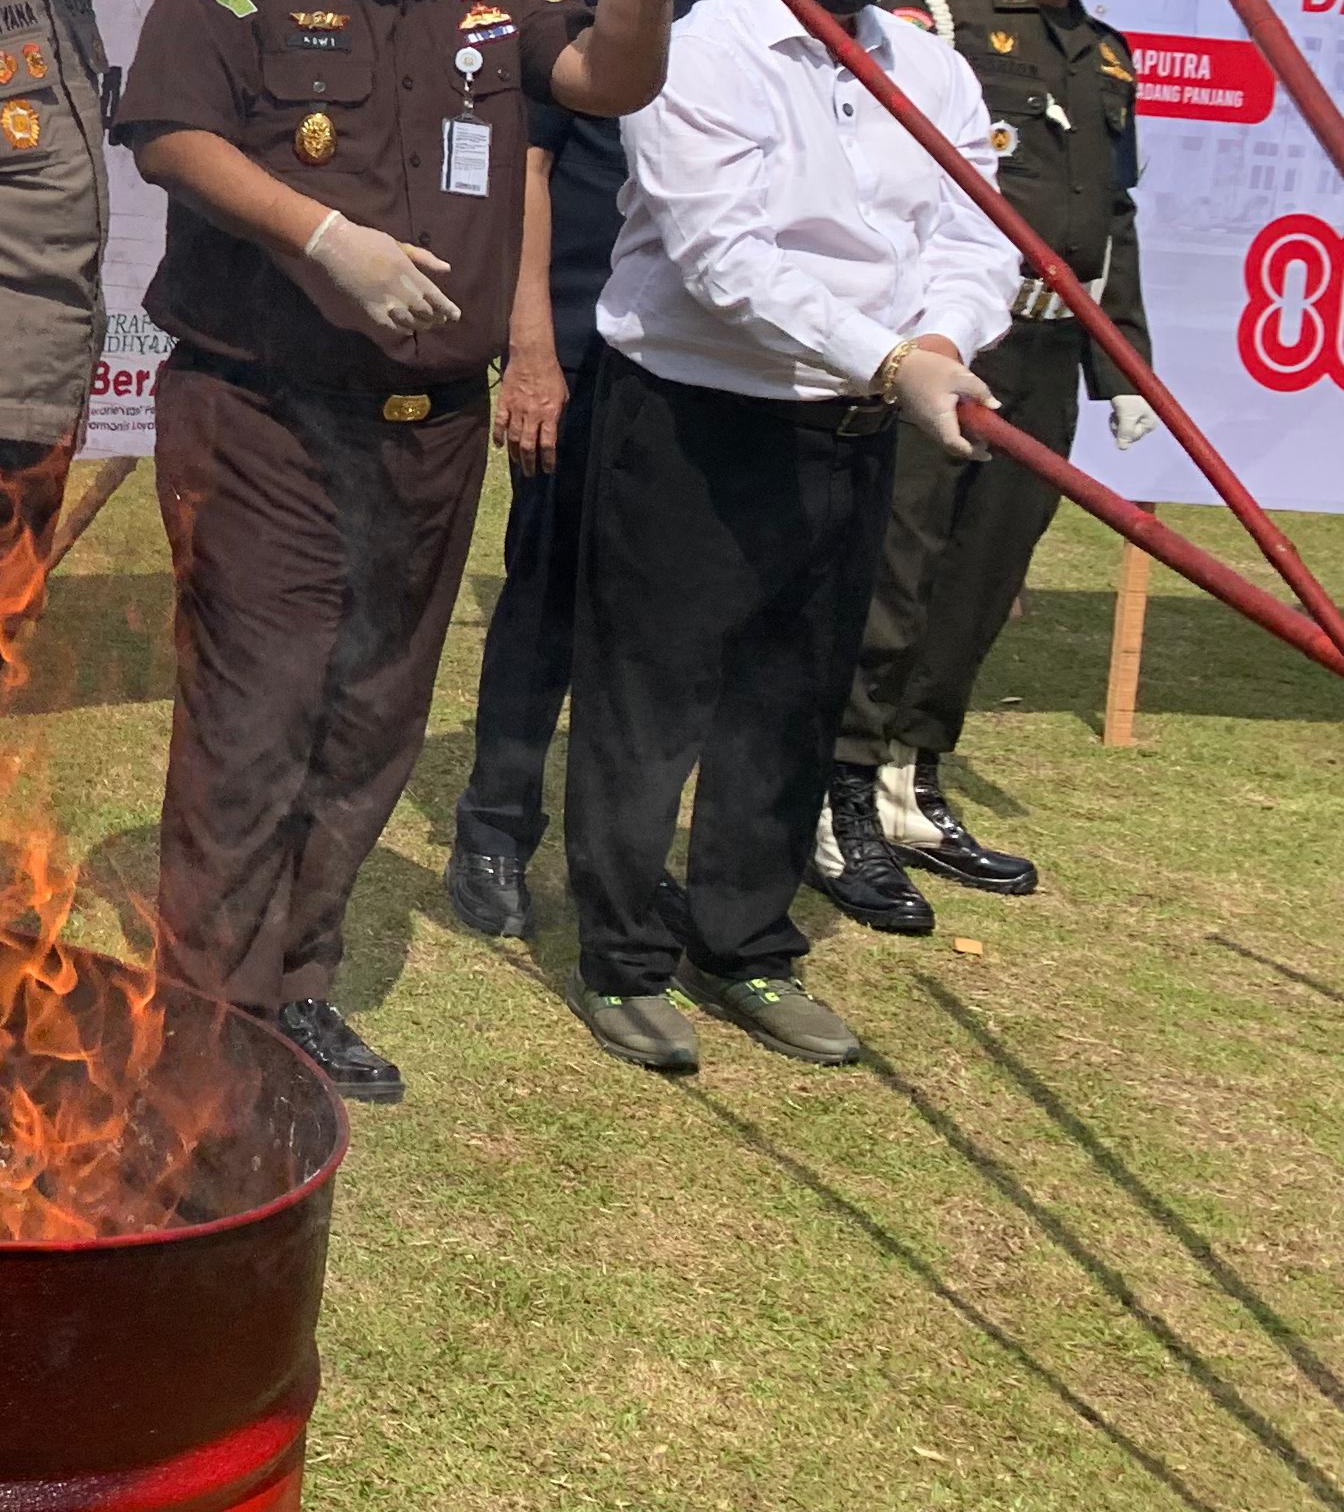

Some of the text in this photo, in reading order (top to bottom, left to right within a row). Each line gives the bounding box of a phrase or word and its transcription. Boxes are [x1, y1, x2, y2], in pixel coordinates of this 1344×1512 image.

[1131, 49, 1211, 81] APUTRA
[1136, 84, 1244, 109] ADANG PANJANG
